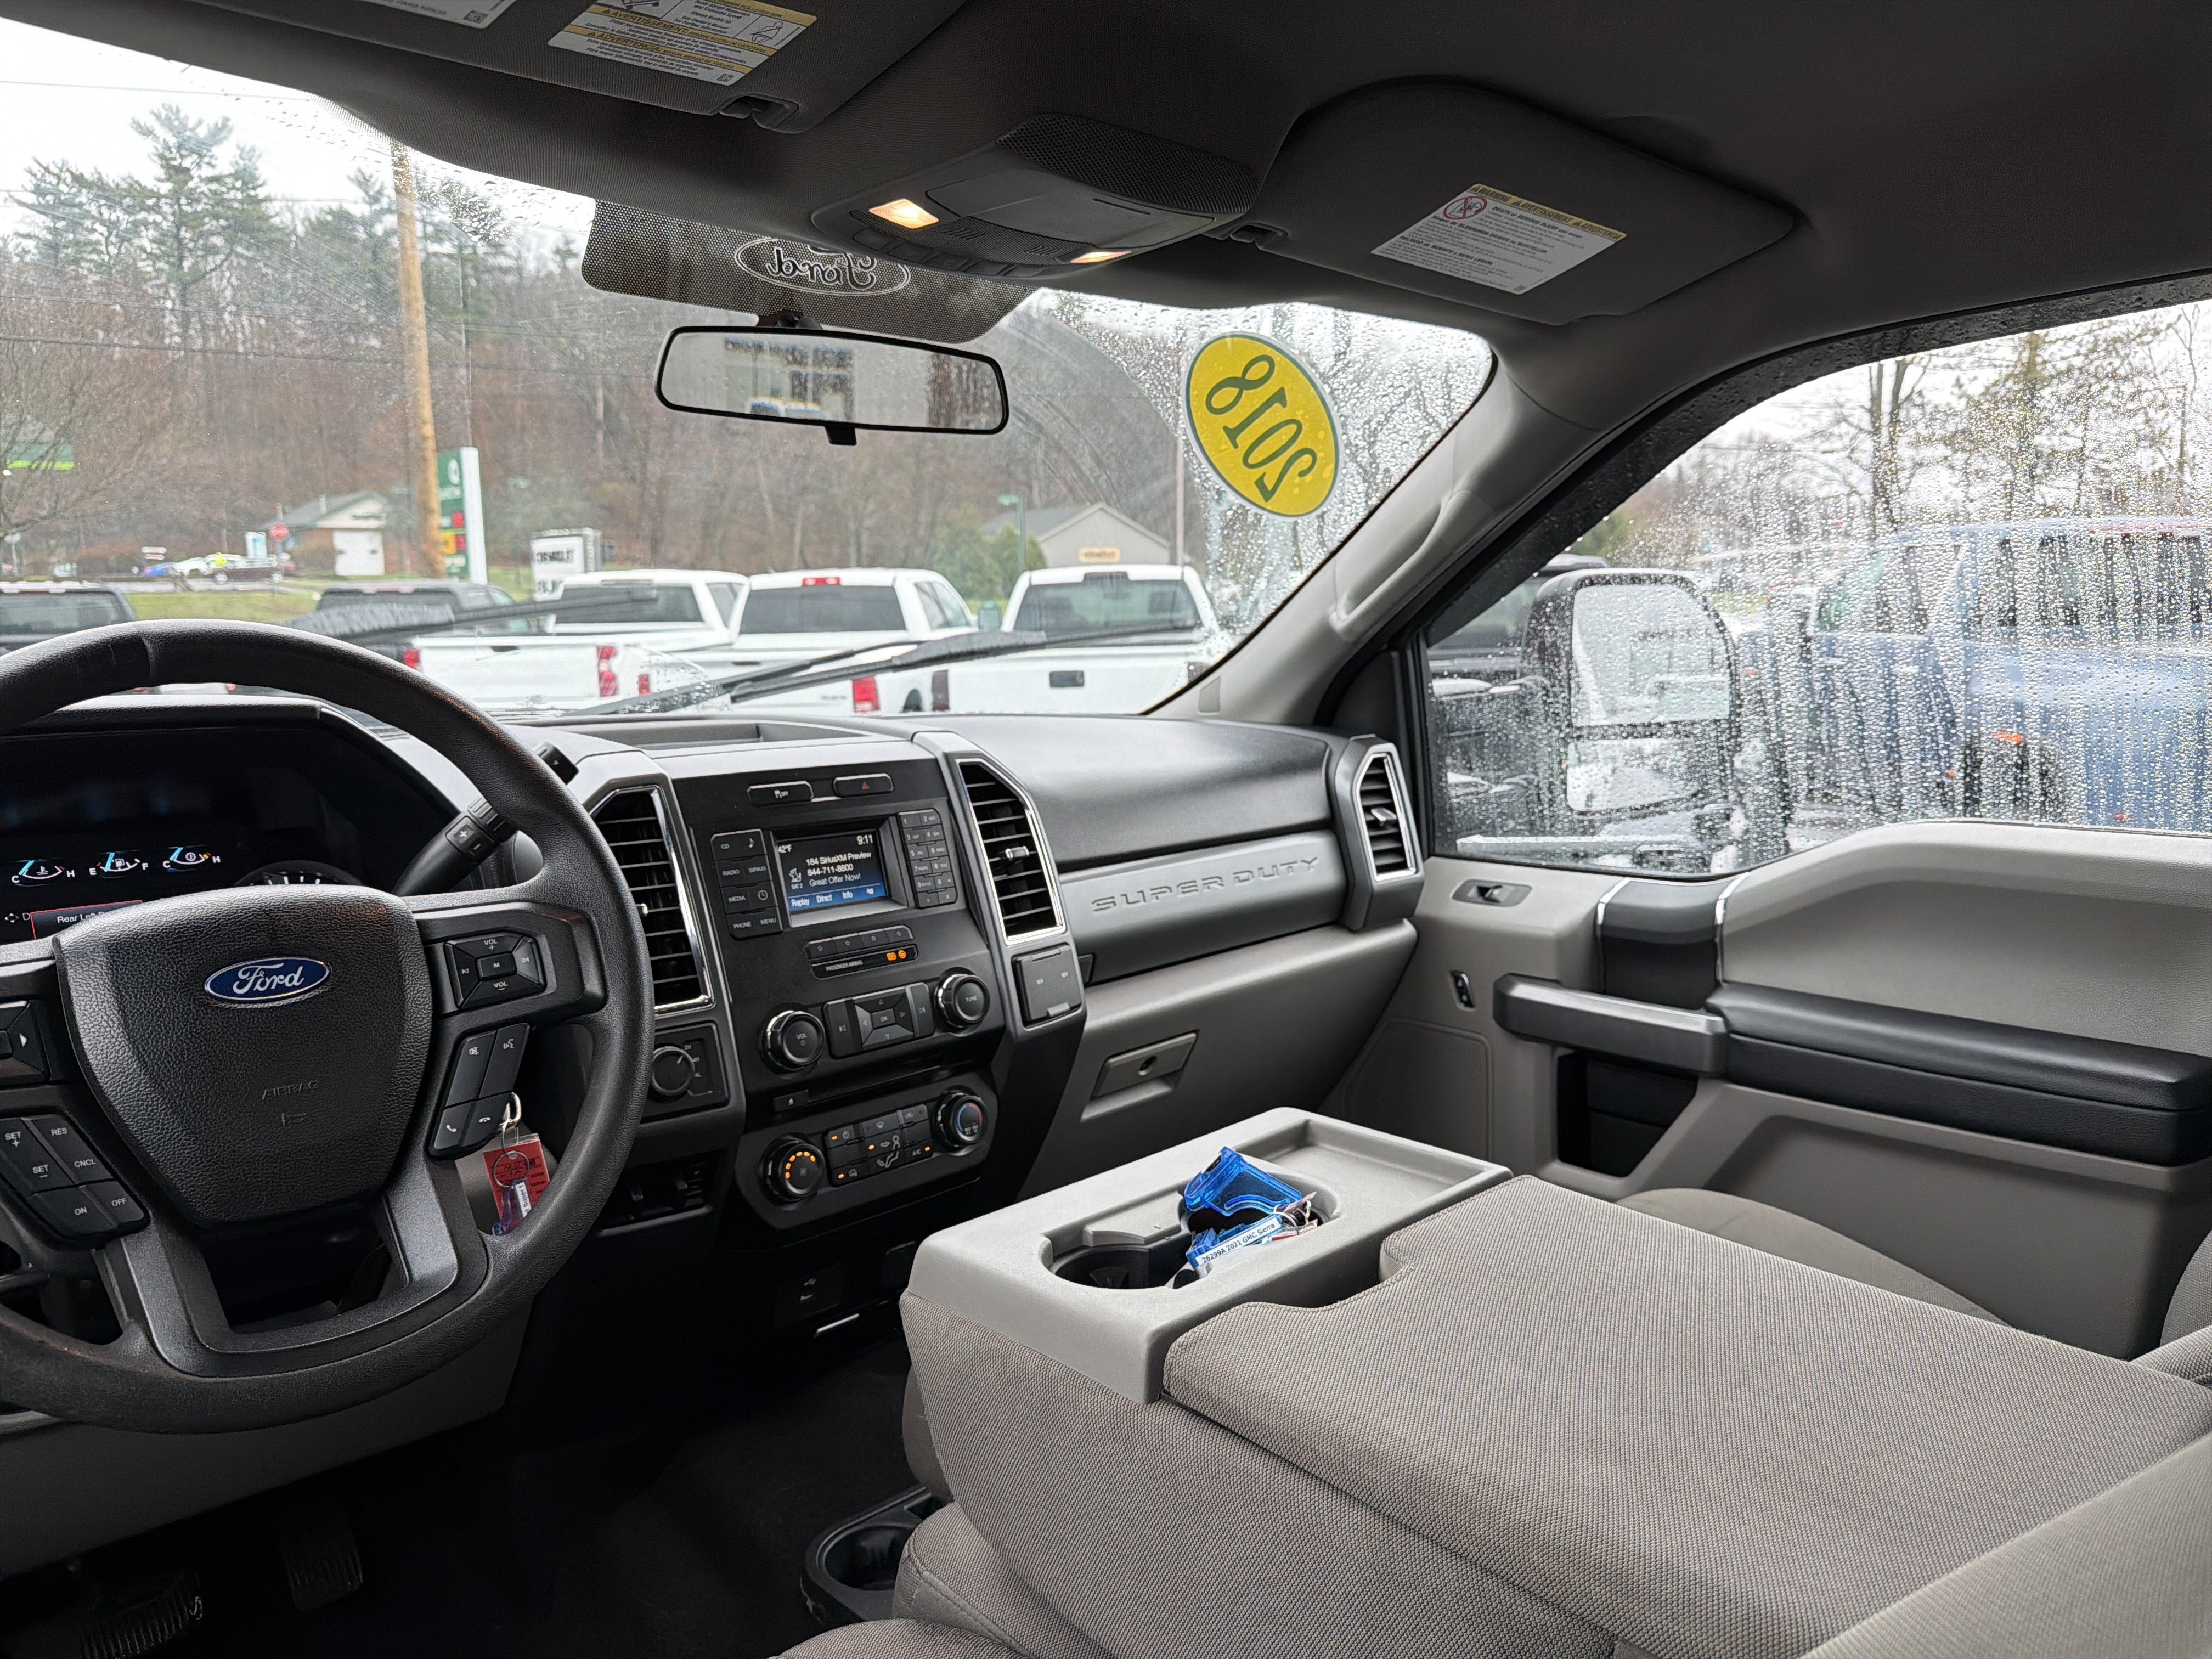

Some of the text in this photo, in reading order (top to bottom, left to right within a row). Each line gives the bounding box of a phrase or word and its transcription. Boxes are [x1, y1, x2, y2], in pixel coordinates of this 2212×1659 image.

[612, 10, 688, 33] AVERTISSEMENT:
[598, 32, 663, 52] ADVERTENCIA:
[857, 834, 873, 845] 9:11
[806, 851, 872, 866] 184 SiriusXM Preview
[142, 862, 149, 871] F
[162, 860, 171, 868] C
[66, 869, 75, 877] H
[807, 864, 854, 876] 844-711-8800
[11, 874, 20, 883] C
[809, 873, 861, 887] Great Offer Now!
[1091, 856, 1318, 912] SUPER DUTY
[791, 898, 810, 907] Replay
[816, 894, 832, 903] Direct
[57, 915, 77, 924] Rear
[825, 962, 849, 972] PASSENGER
[233, 962, 304, 994] Ford
[5, 1131, 21, 1141] SET
[50, 1127, 68, 1136] RES
[74, 1159, 97, 1168] CNCL
[32, 1164, 49, 1174] SET
[111, 1198, 127, 1207] OFF
[74, 1207, 88, 1216] ON
[1201, 1222, 1276, 1264] 26299A 2021 GMC Sierra
